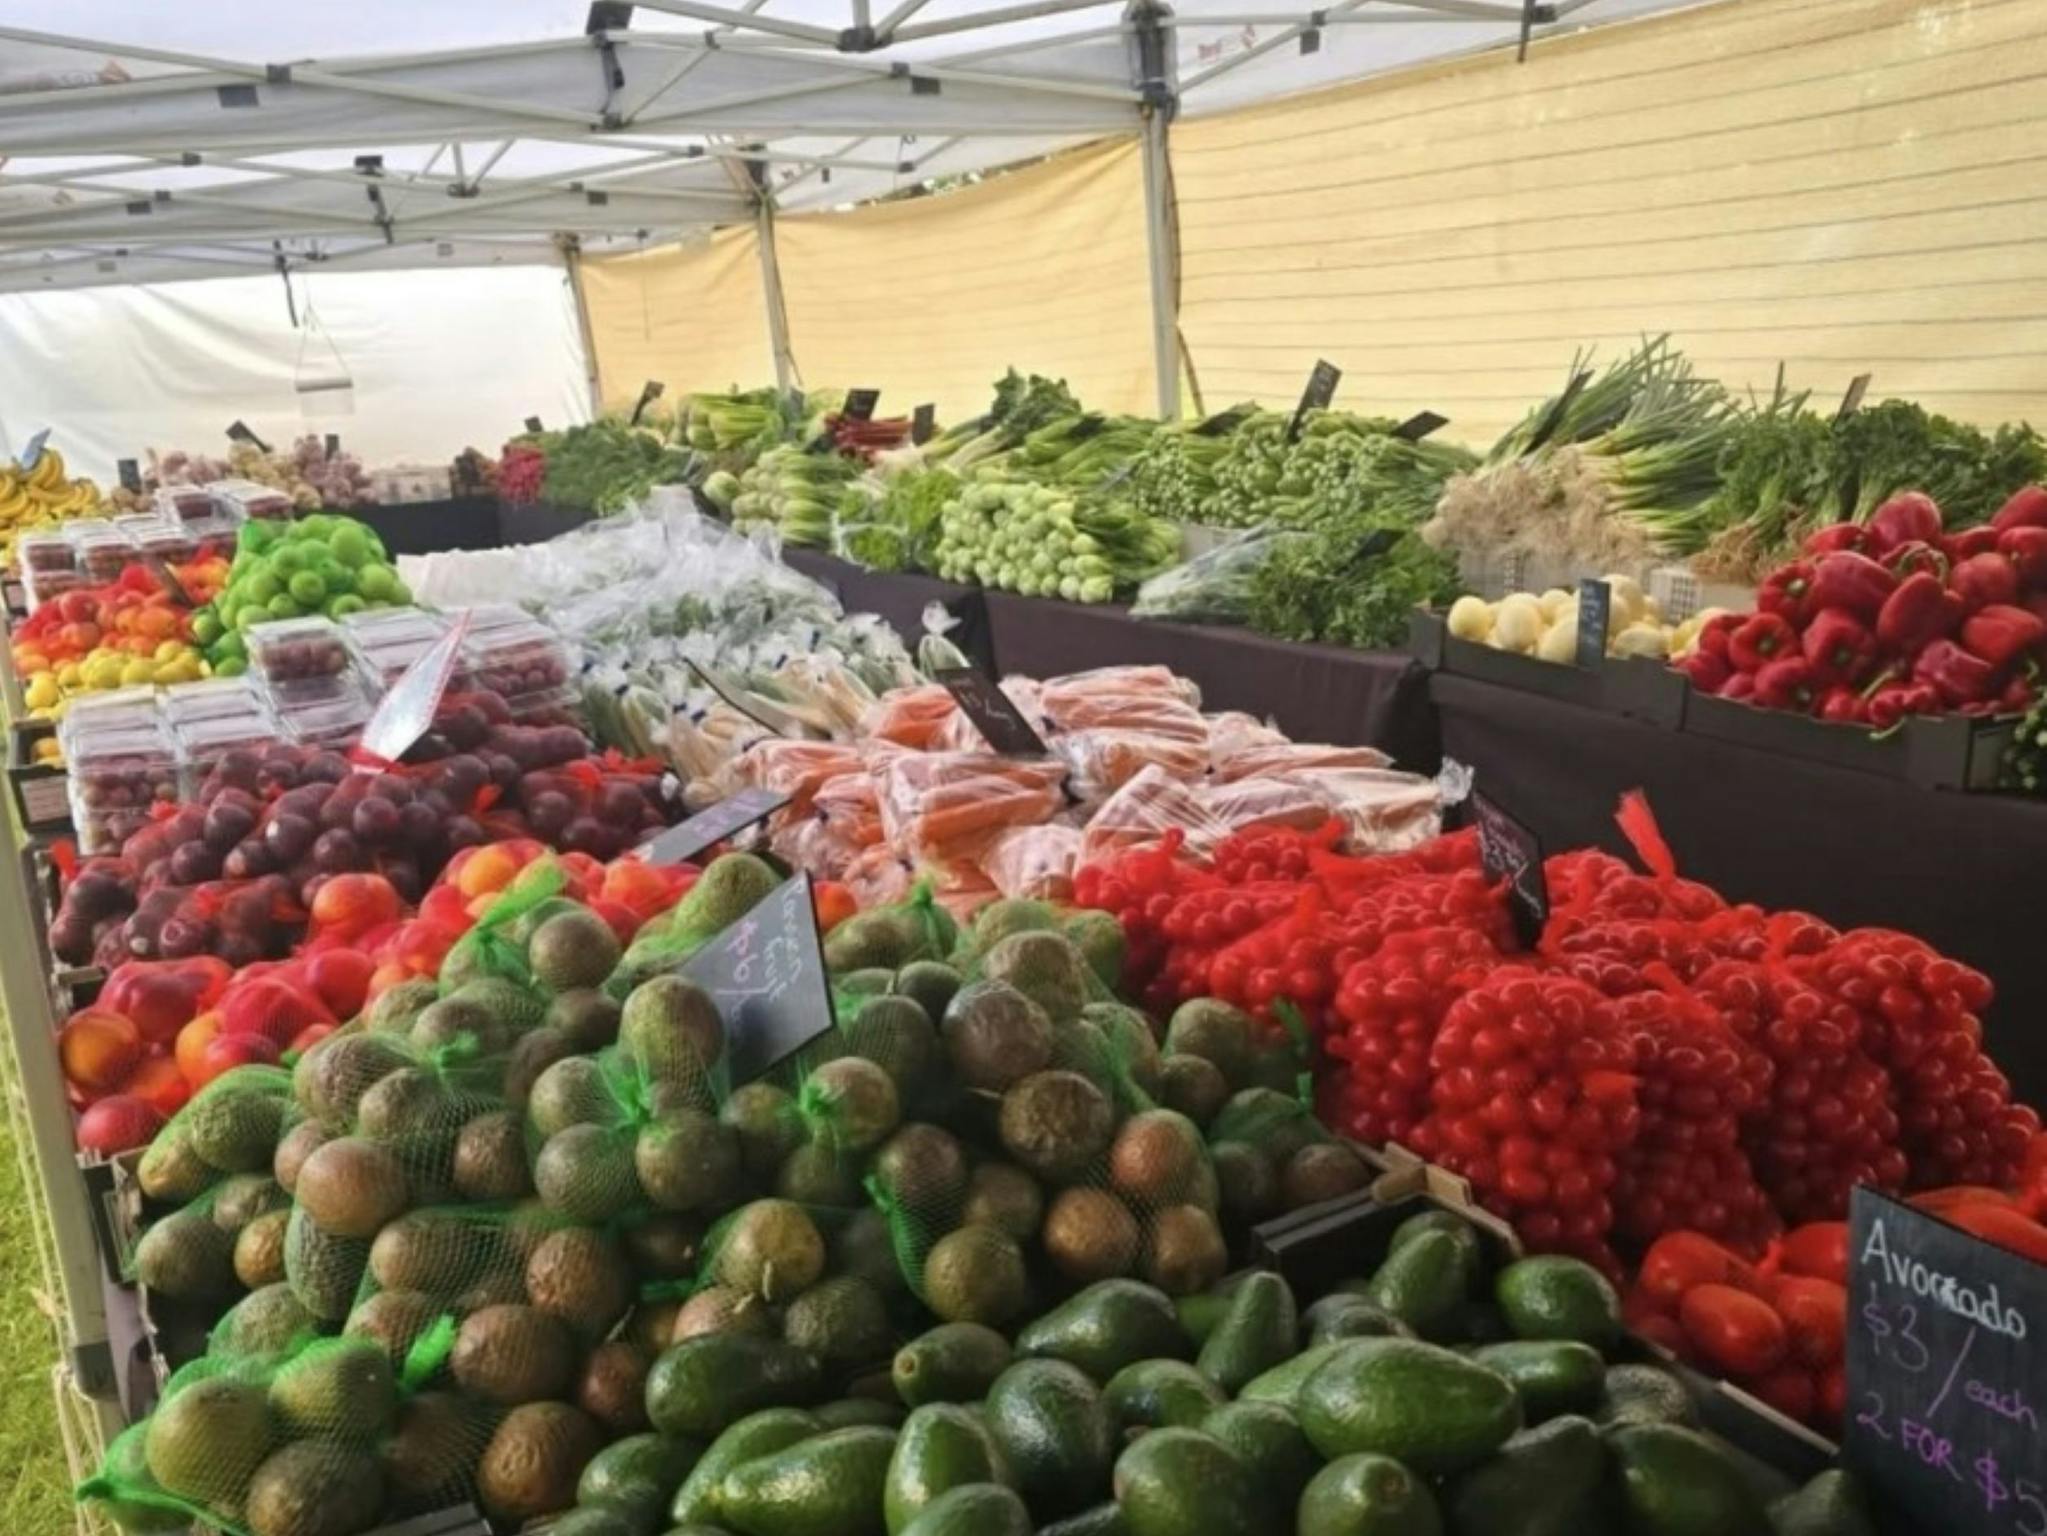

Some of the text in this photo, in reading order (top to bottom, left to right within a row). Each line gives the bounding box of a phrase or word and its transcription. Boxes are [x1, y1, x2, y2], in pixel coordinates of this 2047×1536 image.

[1860, 1216, 2027, 1339] Avocado
[1855, 1391, 1892, 1440] 2
[1900, 1417, 1964, 1482] FOR
[1964, 1376, 2039, 1430] each
